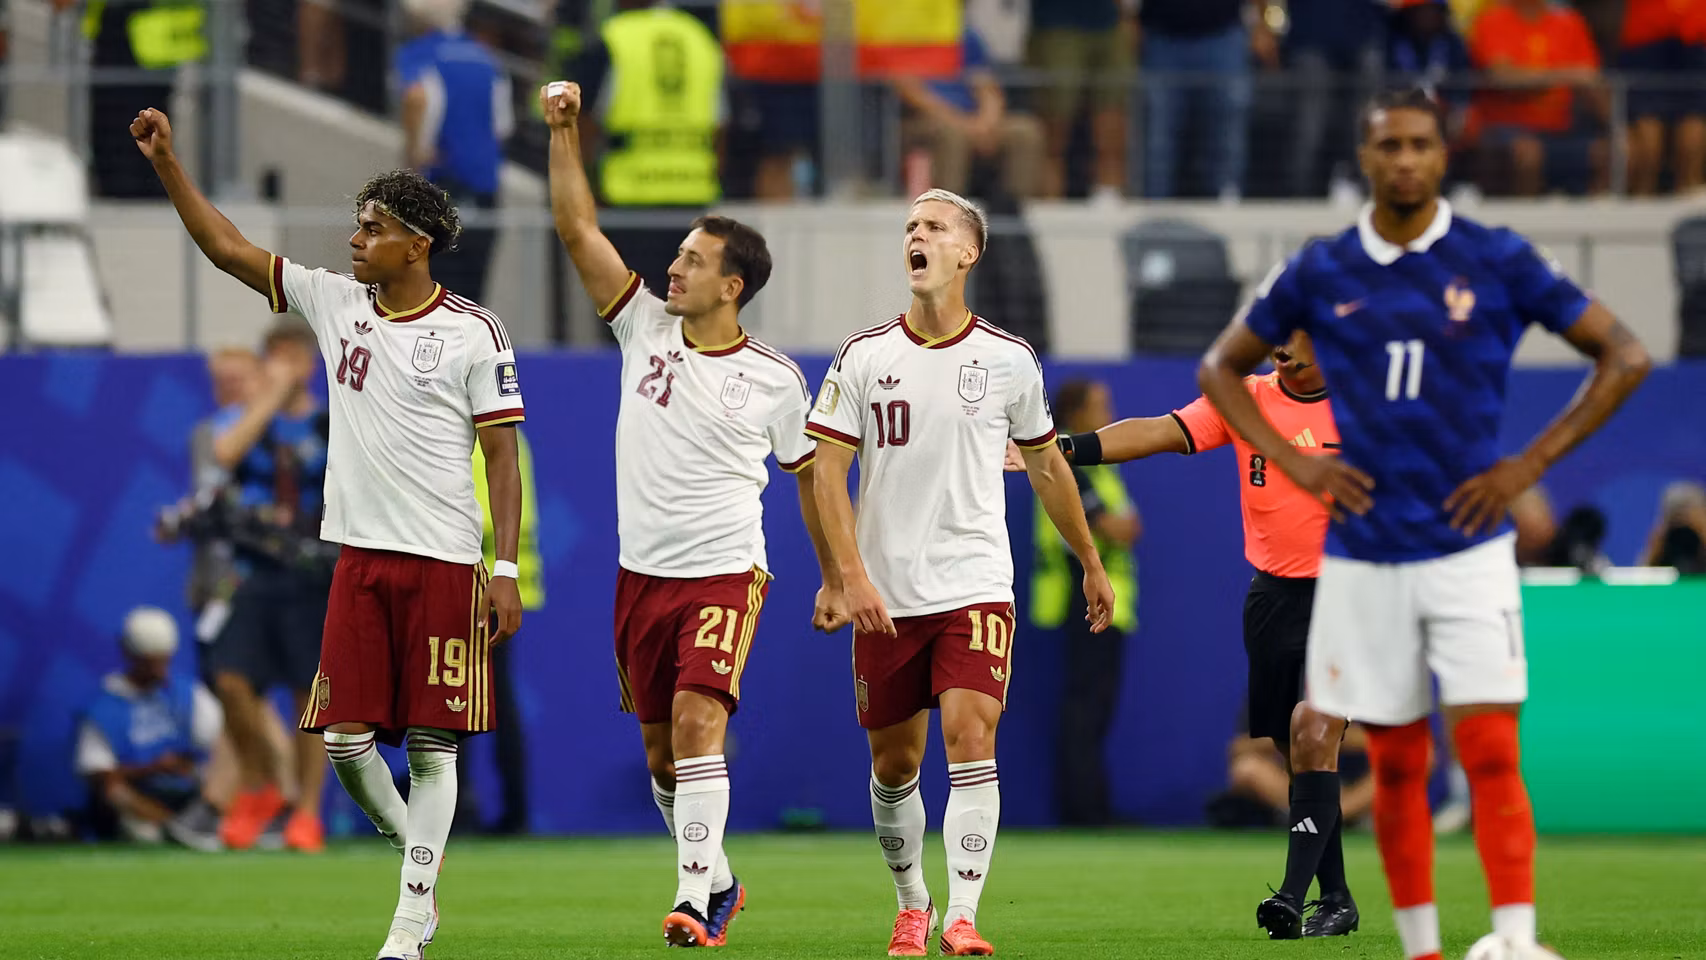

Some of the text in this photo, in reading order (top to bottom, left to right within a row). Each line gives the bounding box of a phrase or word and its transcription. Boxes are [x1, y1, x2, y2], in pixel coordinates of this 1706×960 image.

[337, 337, 372, 393] 19
[636, 355, 674, 408] 21
[1384, 339, 1424, 402] 11
[870, 400, 910, 448] 10
[694, 606, 738, 654] 21
[968, 610, 1007, 658] 10
[428, 636, 467, 687] 19
